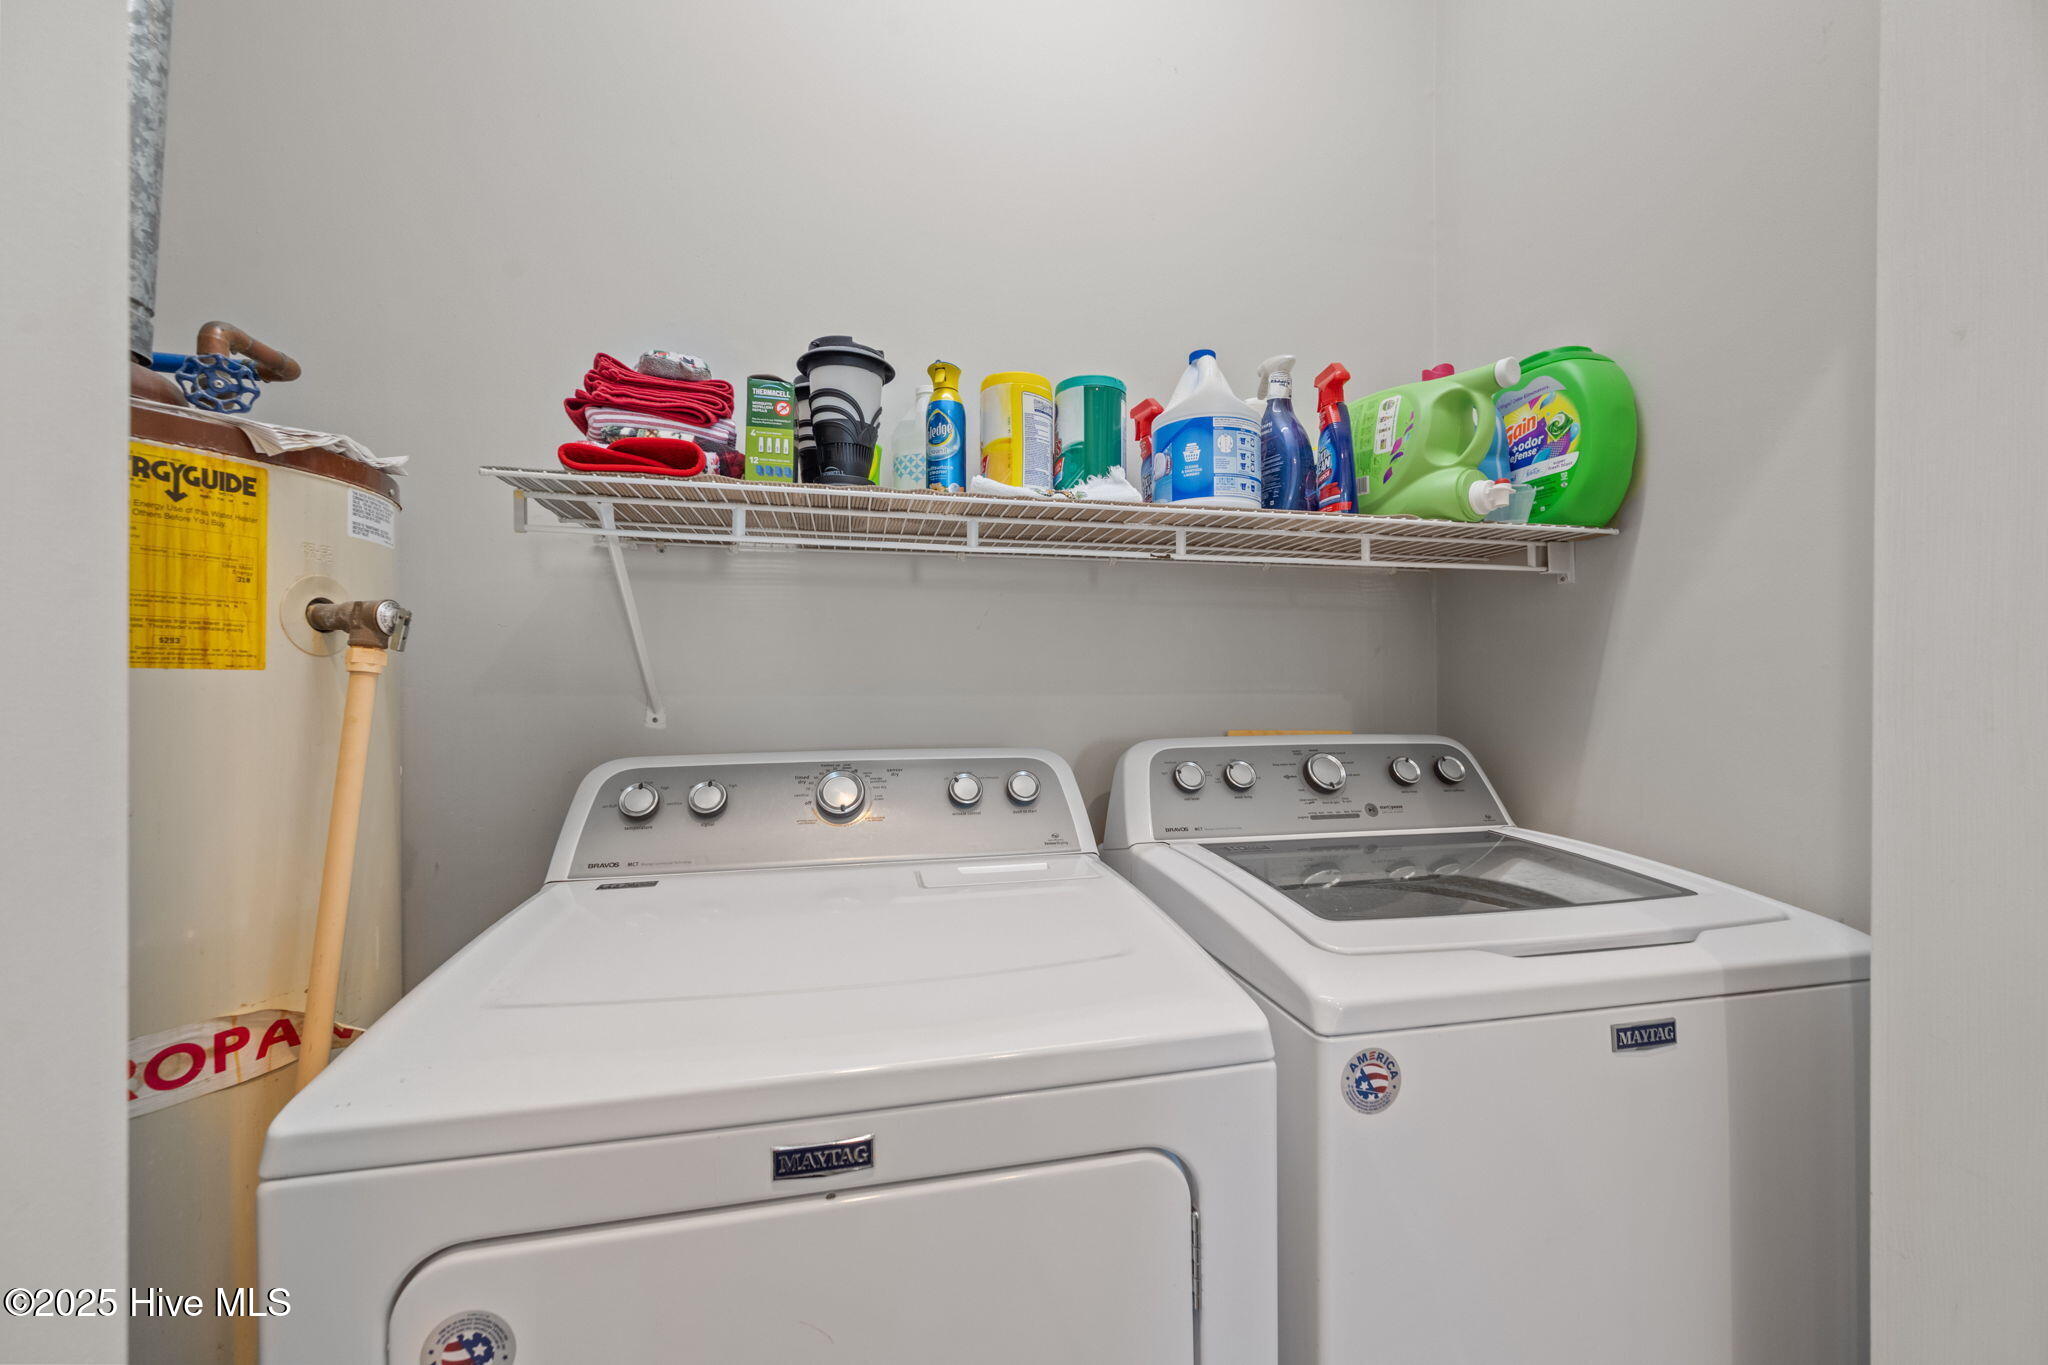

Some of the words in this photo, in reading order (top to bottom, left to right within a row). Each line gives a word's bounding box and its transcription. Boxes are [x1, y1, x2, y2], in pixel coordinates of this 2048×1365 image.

[752, 387, 791, 398] THERMACELL
[928, 422, 953, 440] ledge
[1504, 415, 1537, 446] Gain
[749, 456, 759, 464] 12
[1509, 447, 1537, 464] efense
[133, 499, 164, 511] Energy
[166, 503, 183, 513] Use
[195, 508, 209, 516] this
[132, 508, 162, 519] Others
[164, 513, 190, 522] Before
[193, 517, 210, 526] You
[210, 519, 225, 528] Buy
[587, 861, 620, 869] BRAVOS
[1619, 1026, 1674, 1046] MAYTAG
[1349, 1051, 1399, 1080] AMERICA
[778, 1145, 869, 1173] MAYTAG
